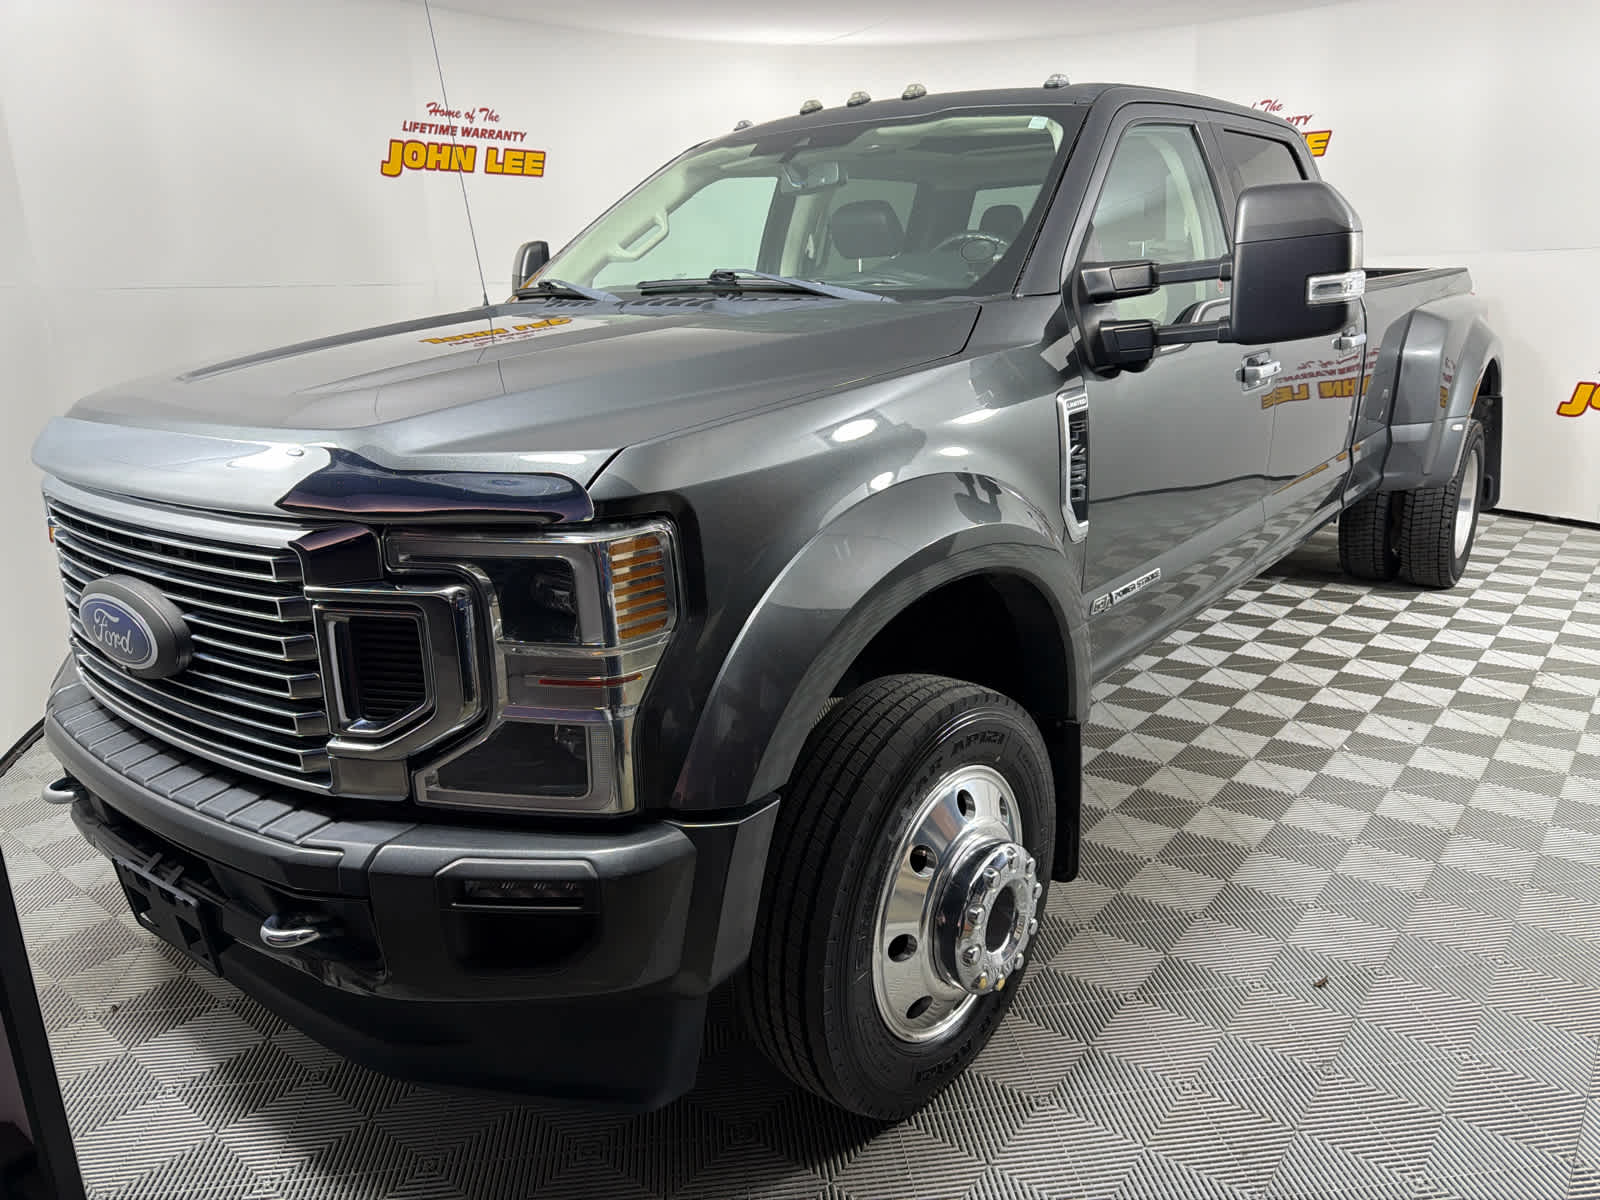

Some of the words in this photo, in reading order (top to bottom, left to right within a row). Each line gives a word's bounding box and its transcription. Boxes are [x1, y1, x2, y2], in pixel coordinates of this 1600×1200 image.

[426, 102, 461, 119] Home
[464, 107, 476, 124] of
[479, 107, 500, 123] The
[402, 119, 458, 137] LIFETIME
[461, 126, 527, 142] WARRANTY
[380, 138, 477, 178] JOHN
[484, 146, 546, 178] LEE
[93, 608, 135, 654] Ford
